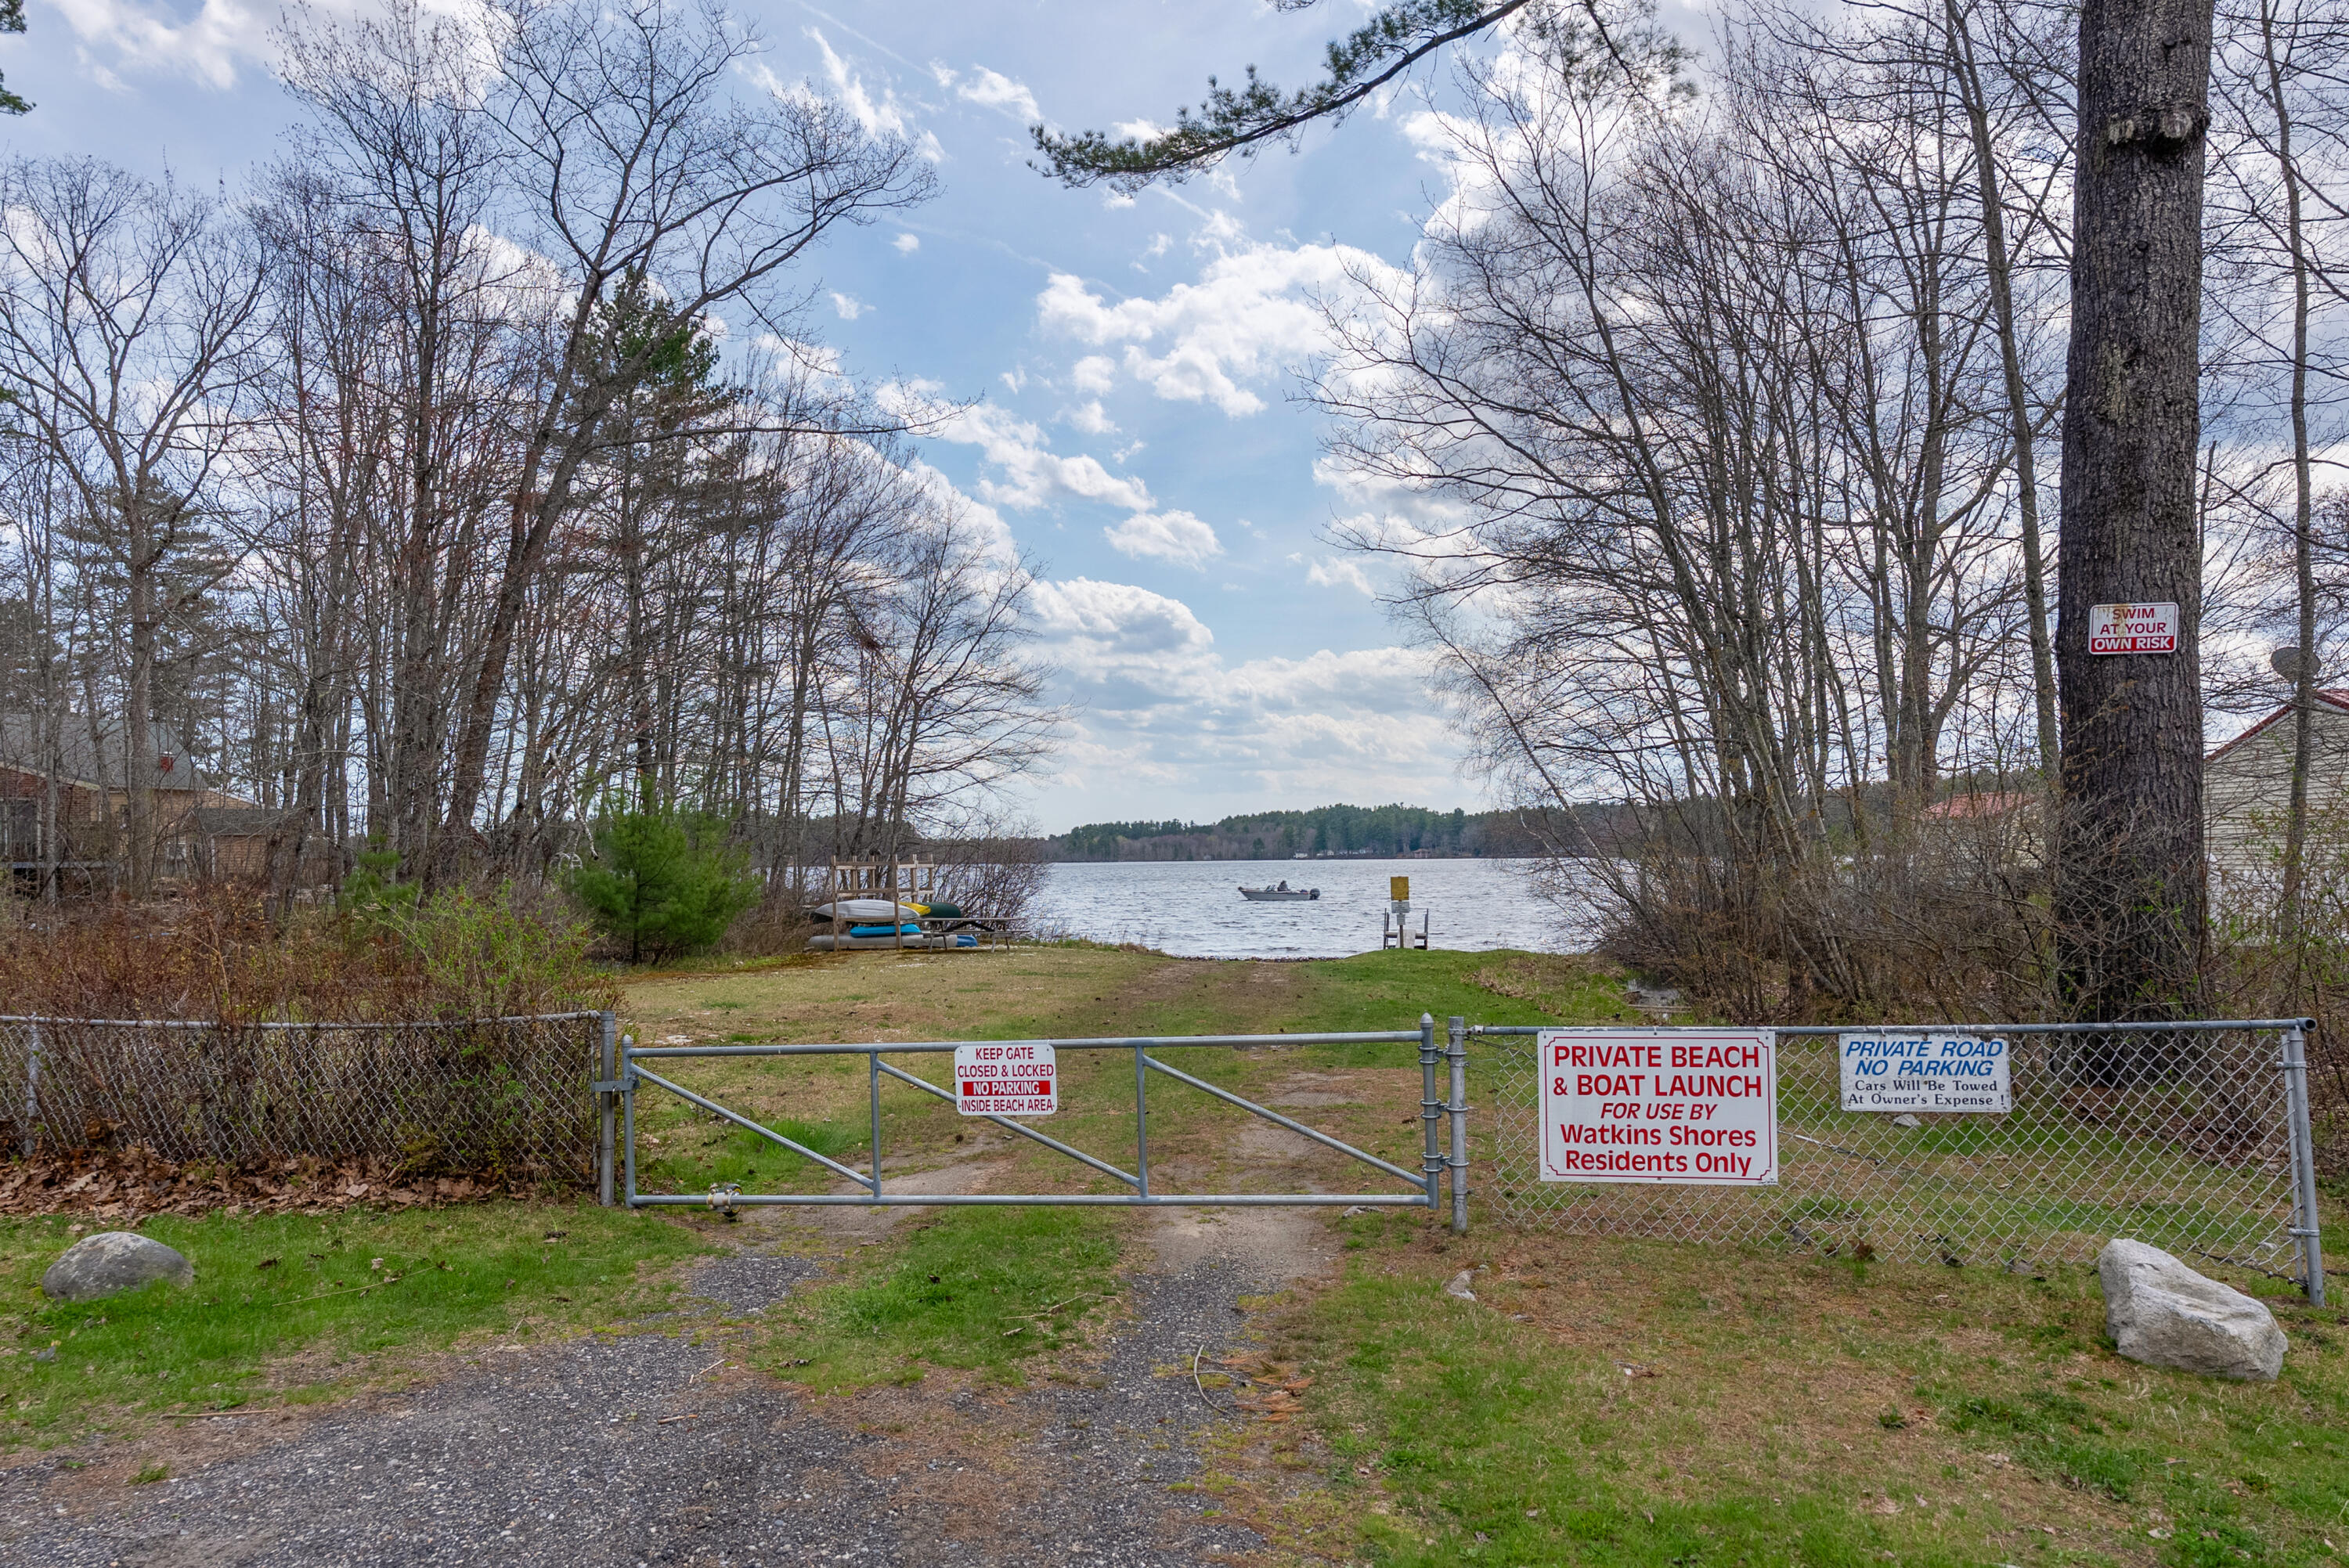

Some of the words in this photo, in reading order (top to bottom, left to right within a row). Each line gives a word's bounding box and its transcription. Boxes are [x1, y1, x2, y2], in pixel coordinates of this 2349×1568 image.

[2113, 607, 2155, 619] SWIM
[2100, 624, 2120, 635] AT
[2125, 622, 2167, 634] YOUR
[2095, 638, 2131, 651] OWN
[2136, 636, 2170, 649] RISK
[976, 1047, 1003, 1060] KEEP
[1006, 1047, 1034, 1060] GATE
[1846, 1041, 1932, 1057] PRIVATE
[1940, 1041, 2003, 1057] ROAD
[1554, 1046, 1662, 1068] PRIVATE
[1671, 1046, 1759, 1068] BEACH
[958, 1065, 998, 1077] CLOSED
[1001, 1065, 1009, 1077] &
[1012, 1064, 1054, 1076] LOCKED
[1855, 1060, 1889, 1076] NO
[1897, 1060, 1994, 1076] PARKING
[972, 1082, 990, 1095] NO
[991, 1081, 1040, 1095] PARKING
[1553, 1077, 1568, 1096] &
[1577, 1074, 1645, 1097] BOAT
[1654, 1075, 1762, 1098] LAUNCH
[1855, 1080, 1885, 1091] Cars
[1893, 1080, 1920, 1090] Will
[1928, 1080, 1945, 1091] Be
[1952, 1080, 1997, 1091] Towed
[962, 1099, 991, 1112] INSIDE
[994, 1099, 1024, 1112] BEACH
[1027, 1098, 1053, 1112] AREA
[1847, 1094, 1864, 1104] At
[1871, 1094, 1927, 1105] Owner's
[1600, 1102, 1640, 1119] FOR
[1646, 1103, 1684, 1120] USE
[1689, 1103, 1718, 1120] BY
[1560, 1124, 1662, 1145] Watkins
[1669, 1125, 1756, 1147] Shores
[1566, 1150, 1687, 1172] Residents
[1695, 1152, 1752, 1177] Only
